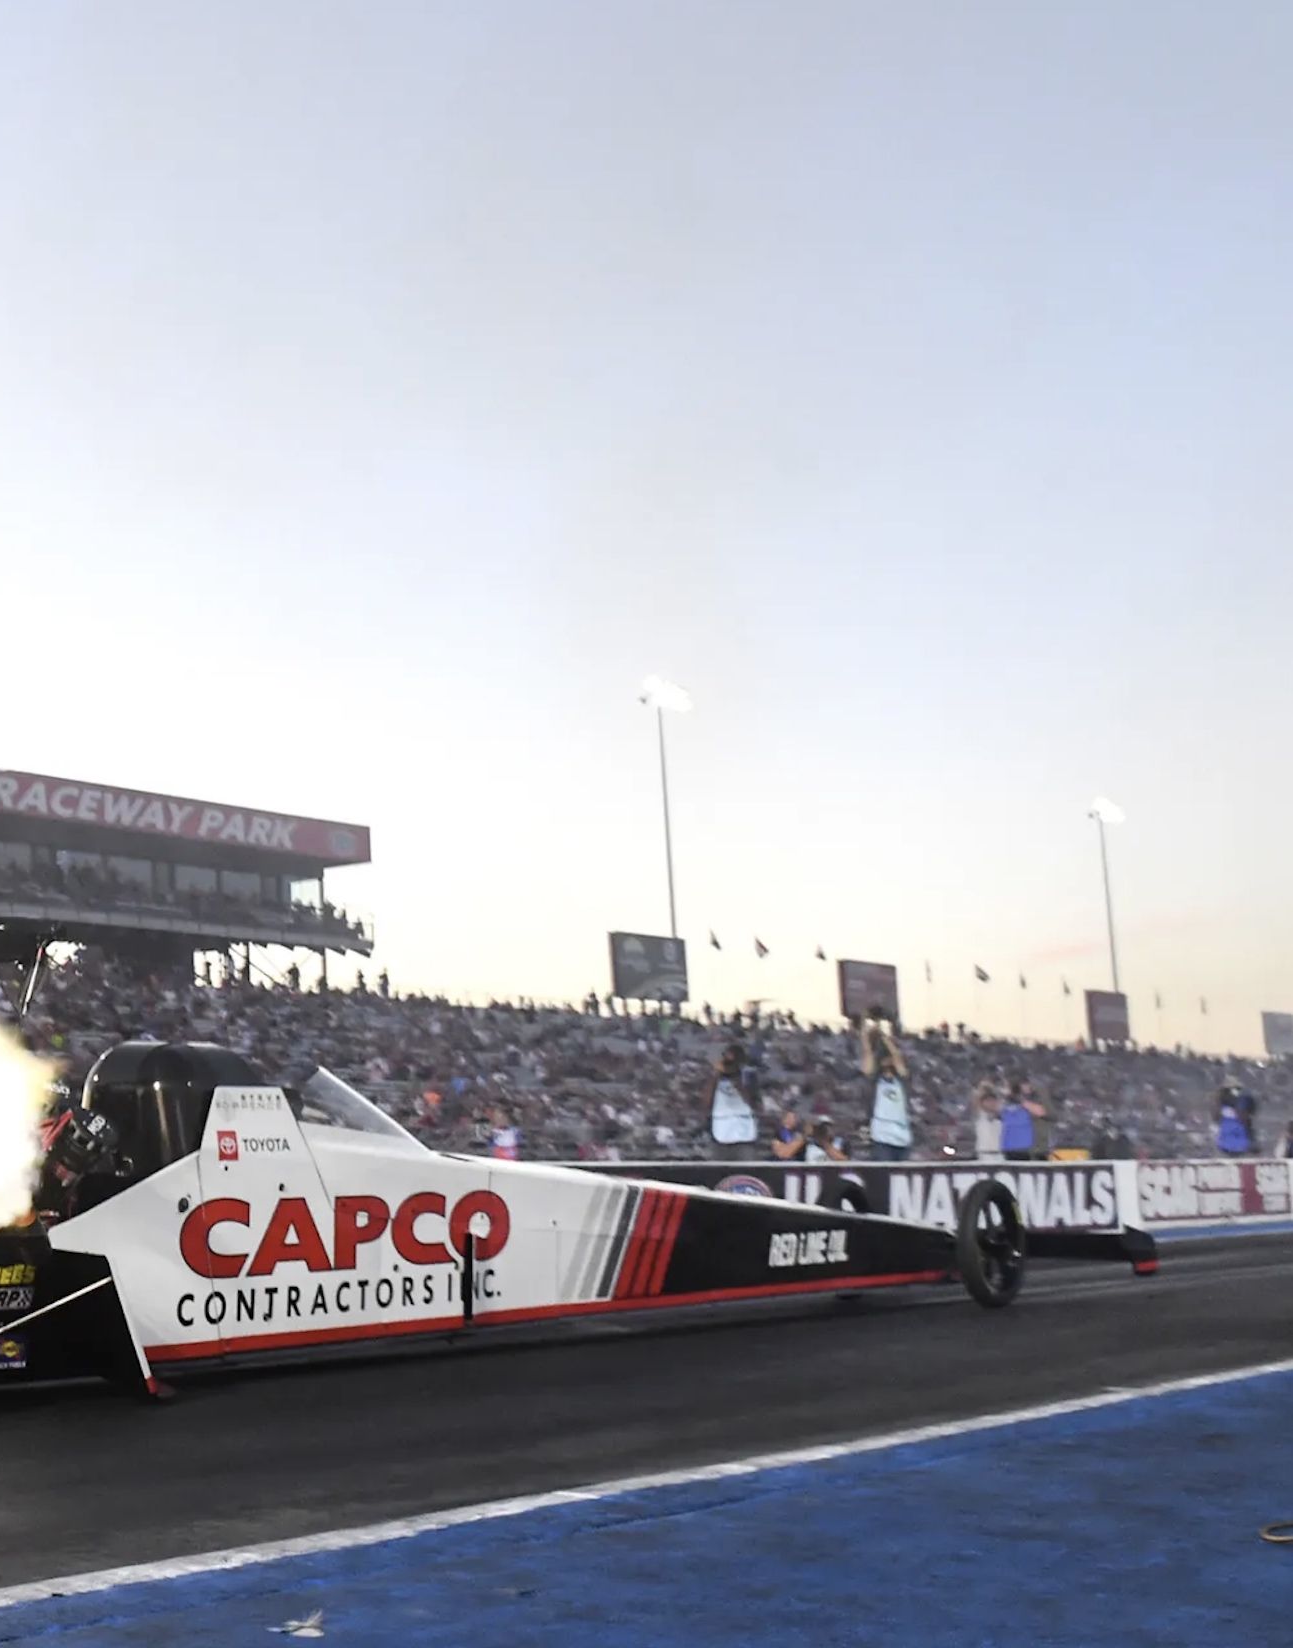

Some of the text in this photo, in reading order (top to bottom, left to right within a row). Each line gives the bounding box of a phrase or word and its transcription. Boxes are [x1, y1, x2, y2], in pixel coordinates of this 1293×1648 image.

[197, 808, 298, 852] PARK
[242, 1137, 291, 1152] TOYOTA
[179, 1189, 511, 1279] CAPCO
[177, 1274, 434, 1327] CONTRACTORS
